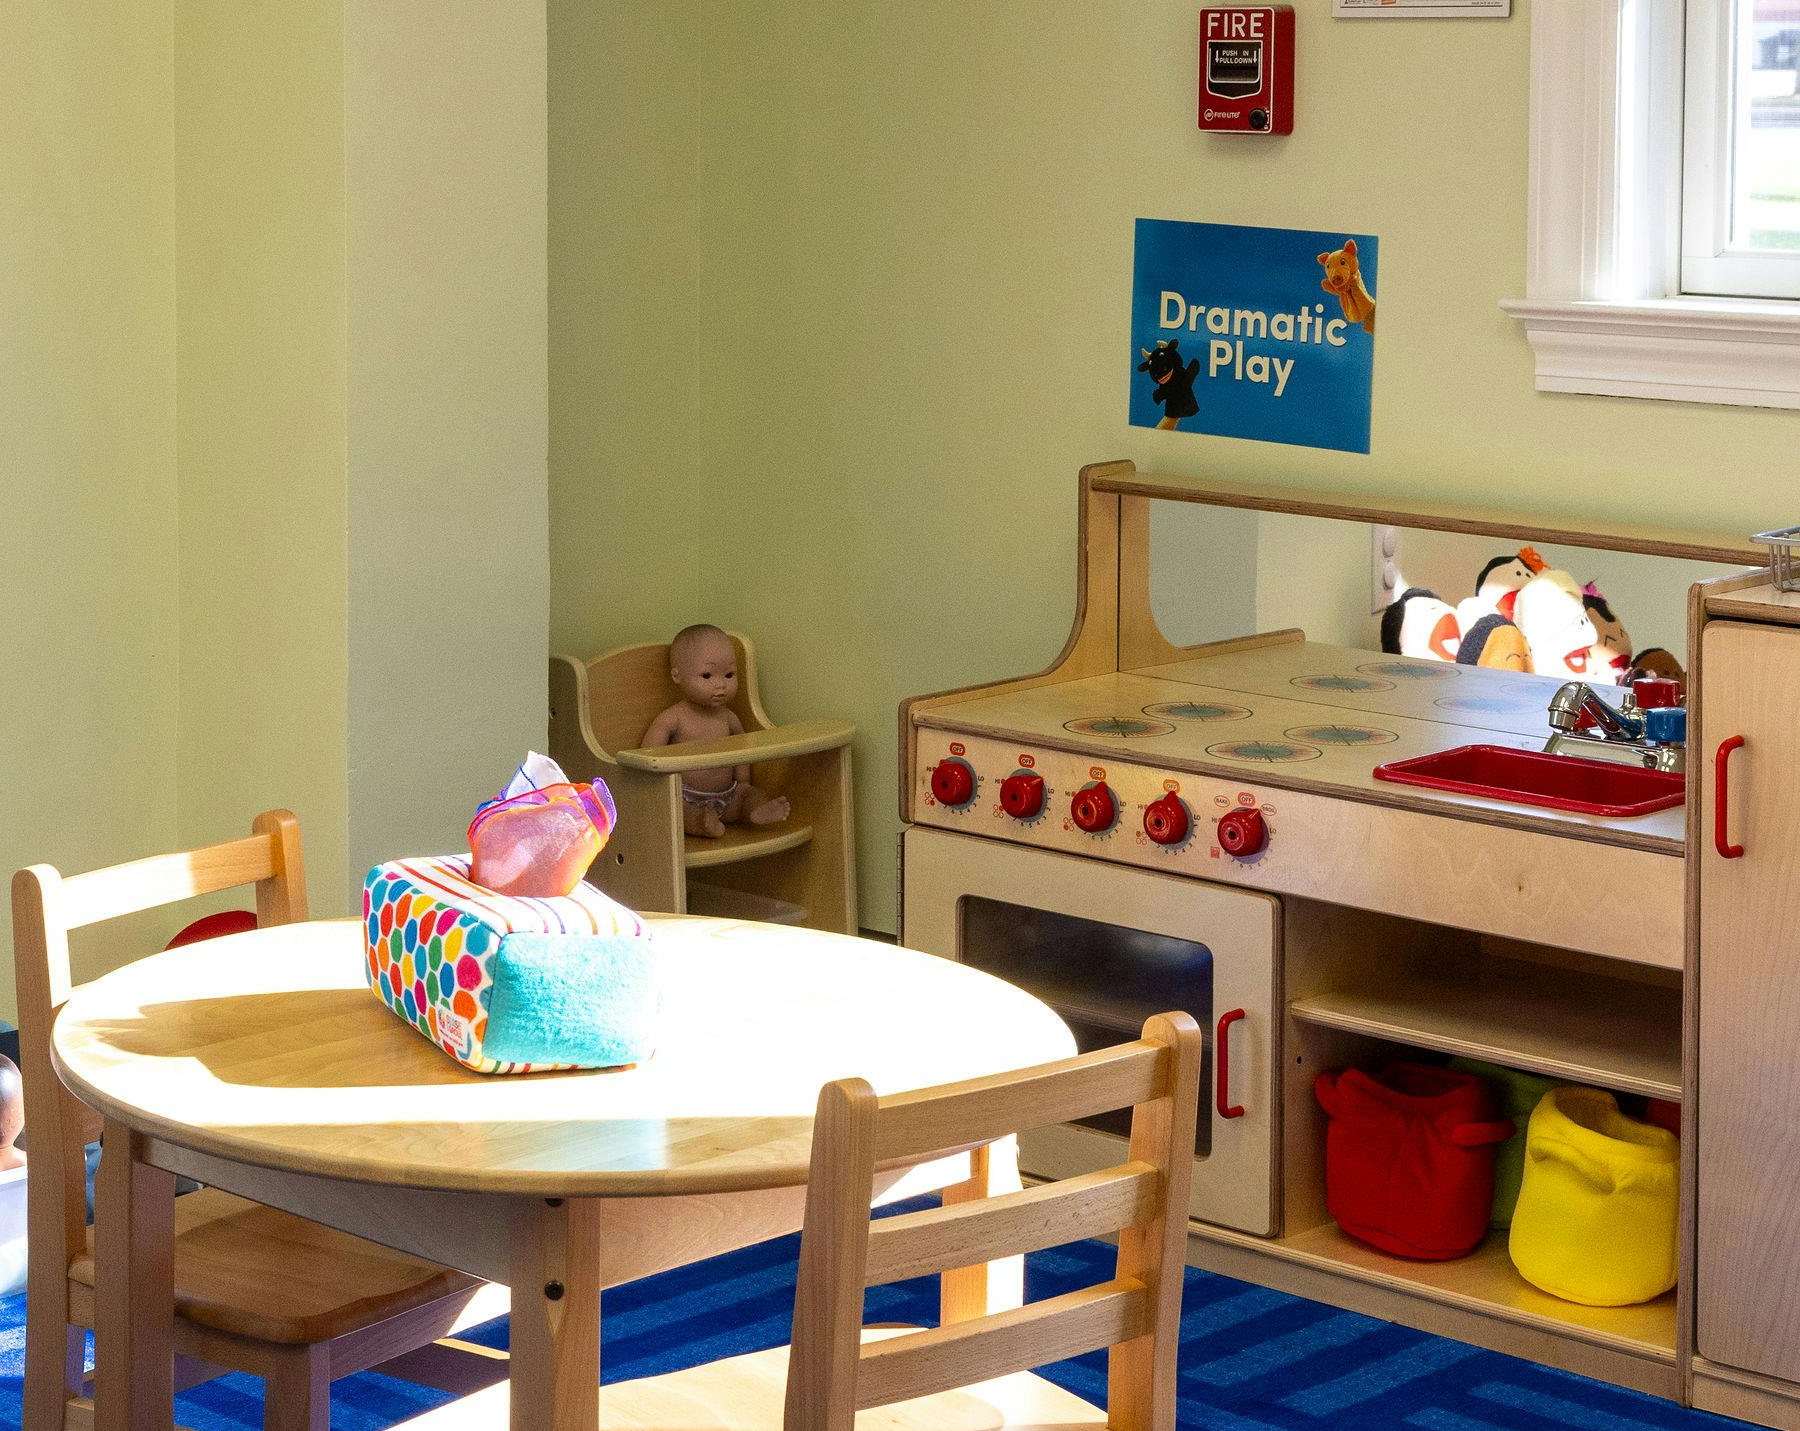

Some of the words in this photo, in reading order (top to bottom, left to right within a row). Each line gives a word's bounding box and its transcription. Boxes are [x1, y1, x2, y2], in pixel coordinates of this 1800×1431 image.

[1207, 13, 1264, 37] FIRE
[1160, 291, 1347, 346] Dramatic
[1209, 339, 1295, 397] Play
